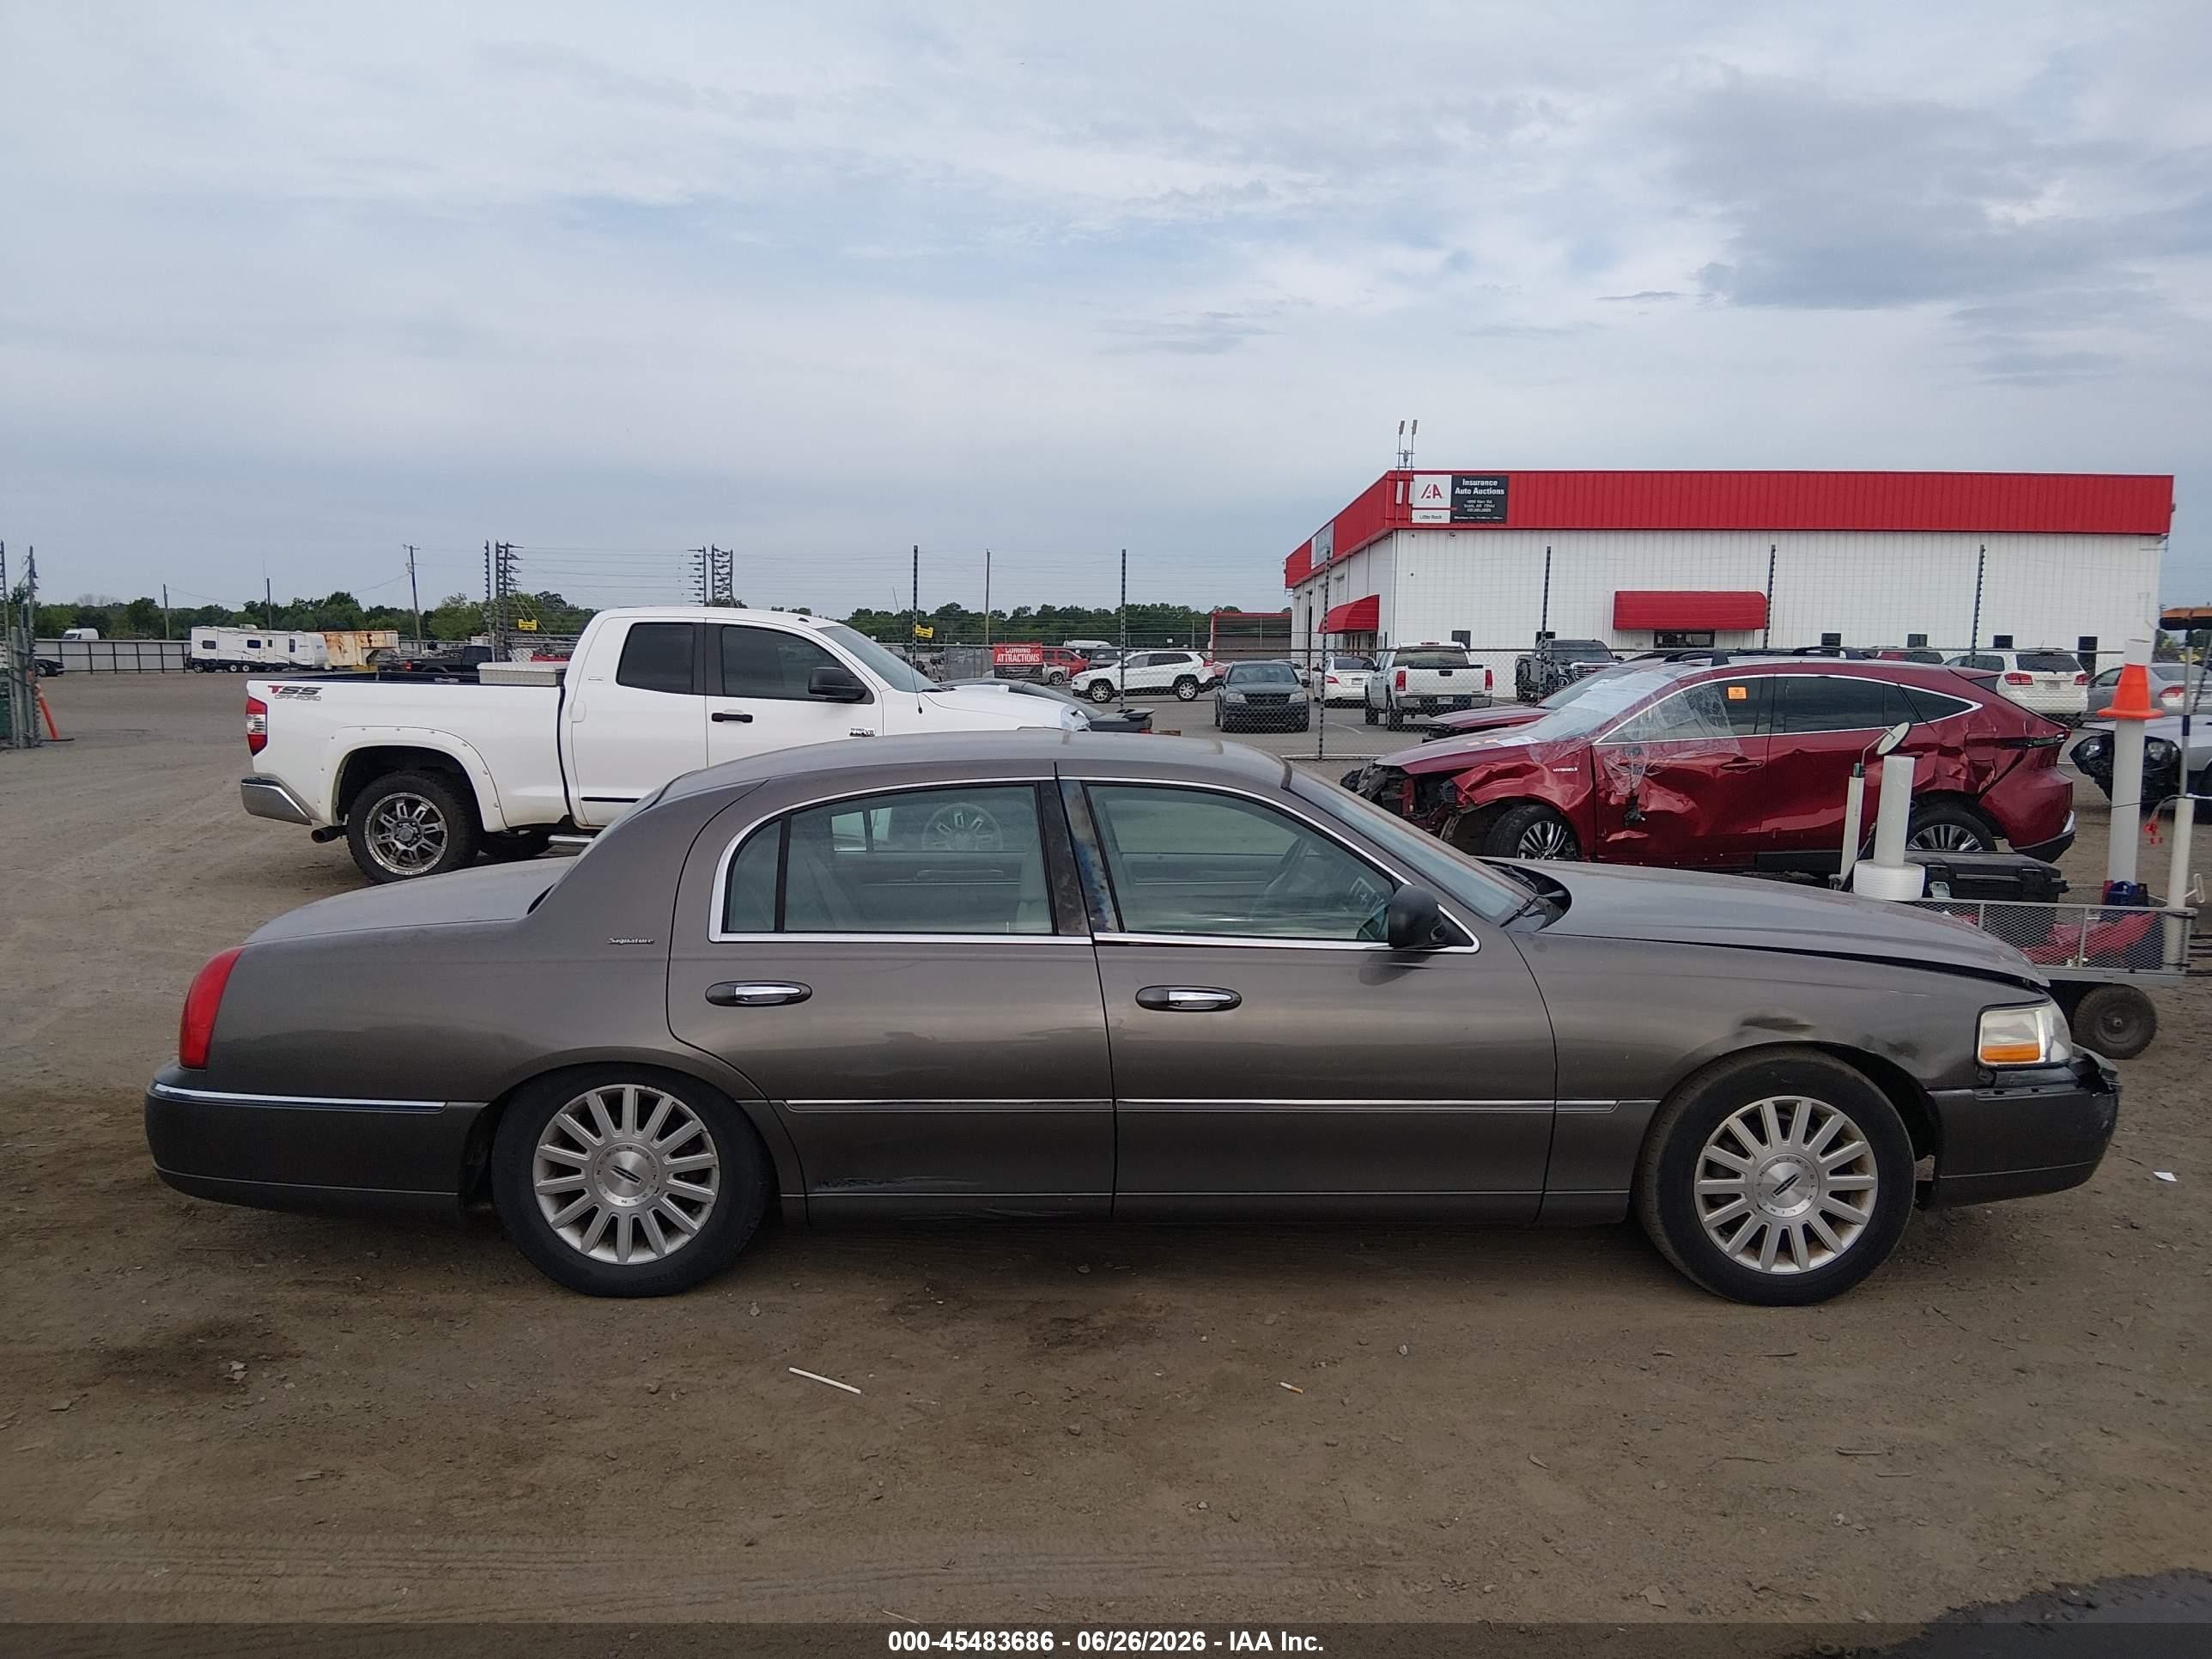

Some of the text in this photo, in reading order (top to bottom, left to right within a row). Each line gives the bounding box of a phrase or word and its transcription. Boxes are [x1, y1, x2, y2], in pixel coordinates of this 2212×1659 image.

[1462, 478, 1498, 487] Insurance
[1455, 487, 1505, 495] Auto Auctions
[996, 653, 1040, 663] ATTRACTIONS
